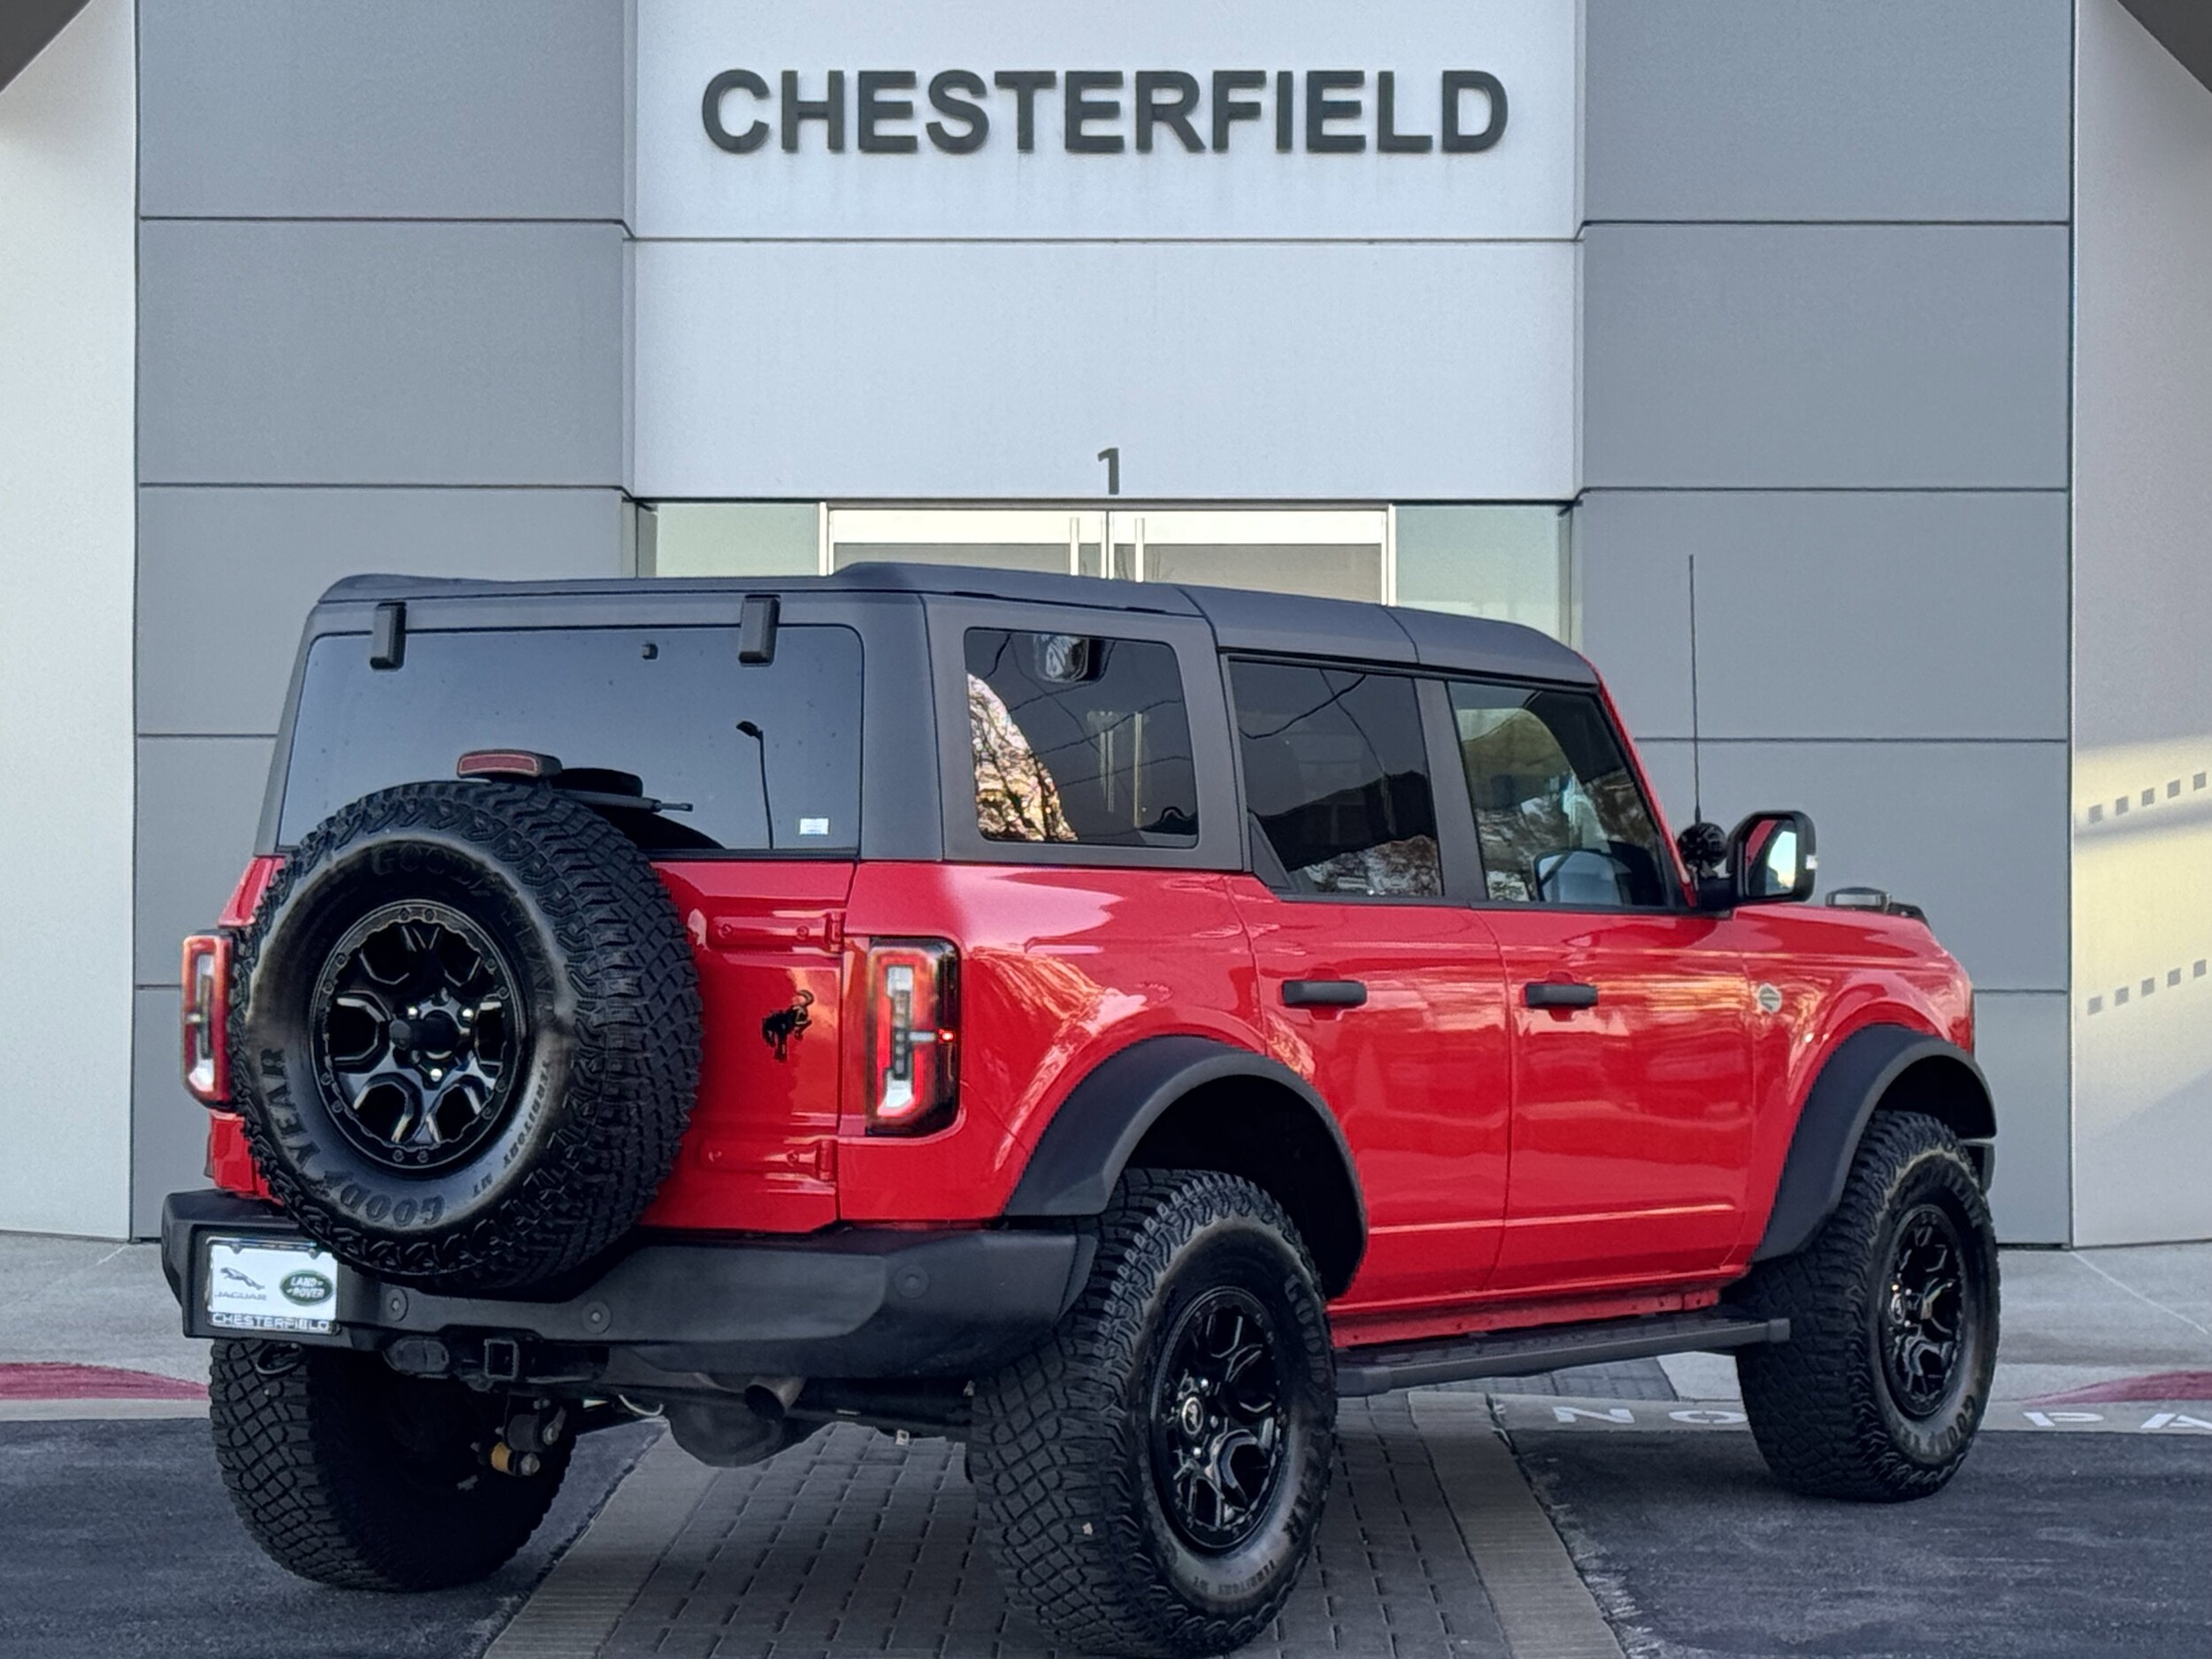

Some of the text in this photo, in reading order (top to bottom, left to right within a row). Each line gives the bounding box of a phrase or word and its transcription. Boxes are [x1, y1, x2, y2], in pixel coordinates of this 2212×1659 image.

[702, 68, 1509, 154] CHESTERFIELD
[1097, 448, 1121, 495] 1
[215, 1290, 267, 1302] JAGUAR
[211, 1312, 330, 1331] CHESTERFIELD
[1552, 1405, 1749, 1425] NO
